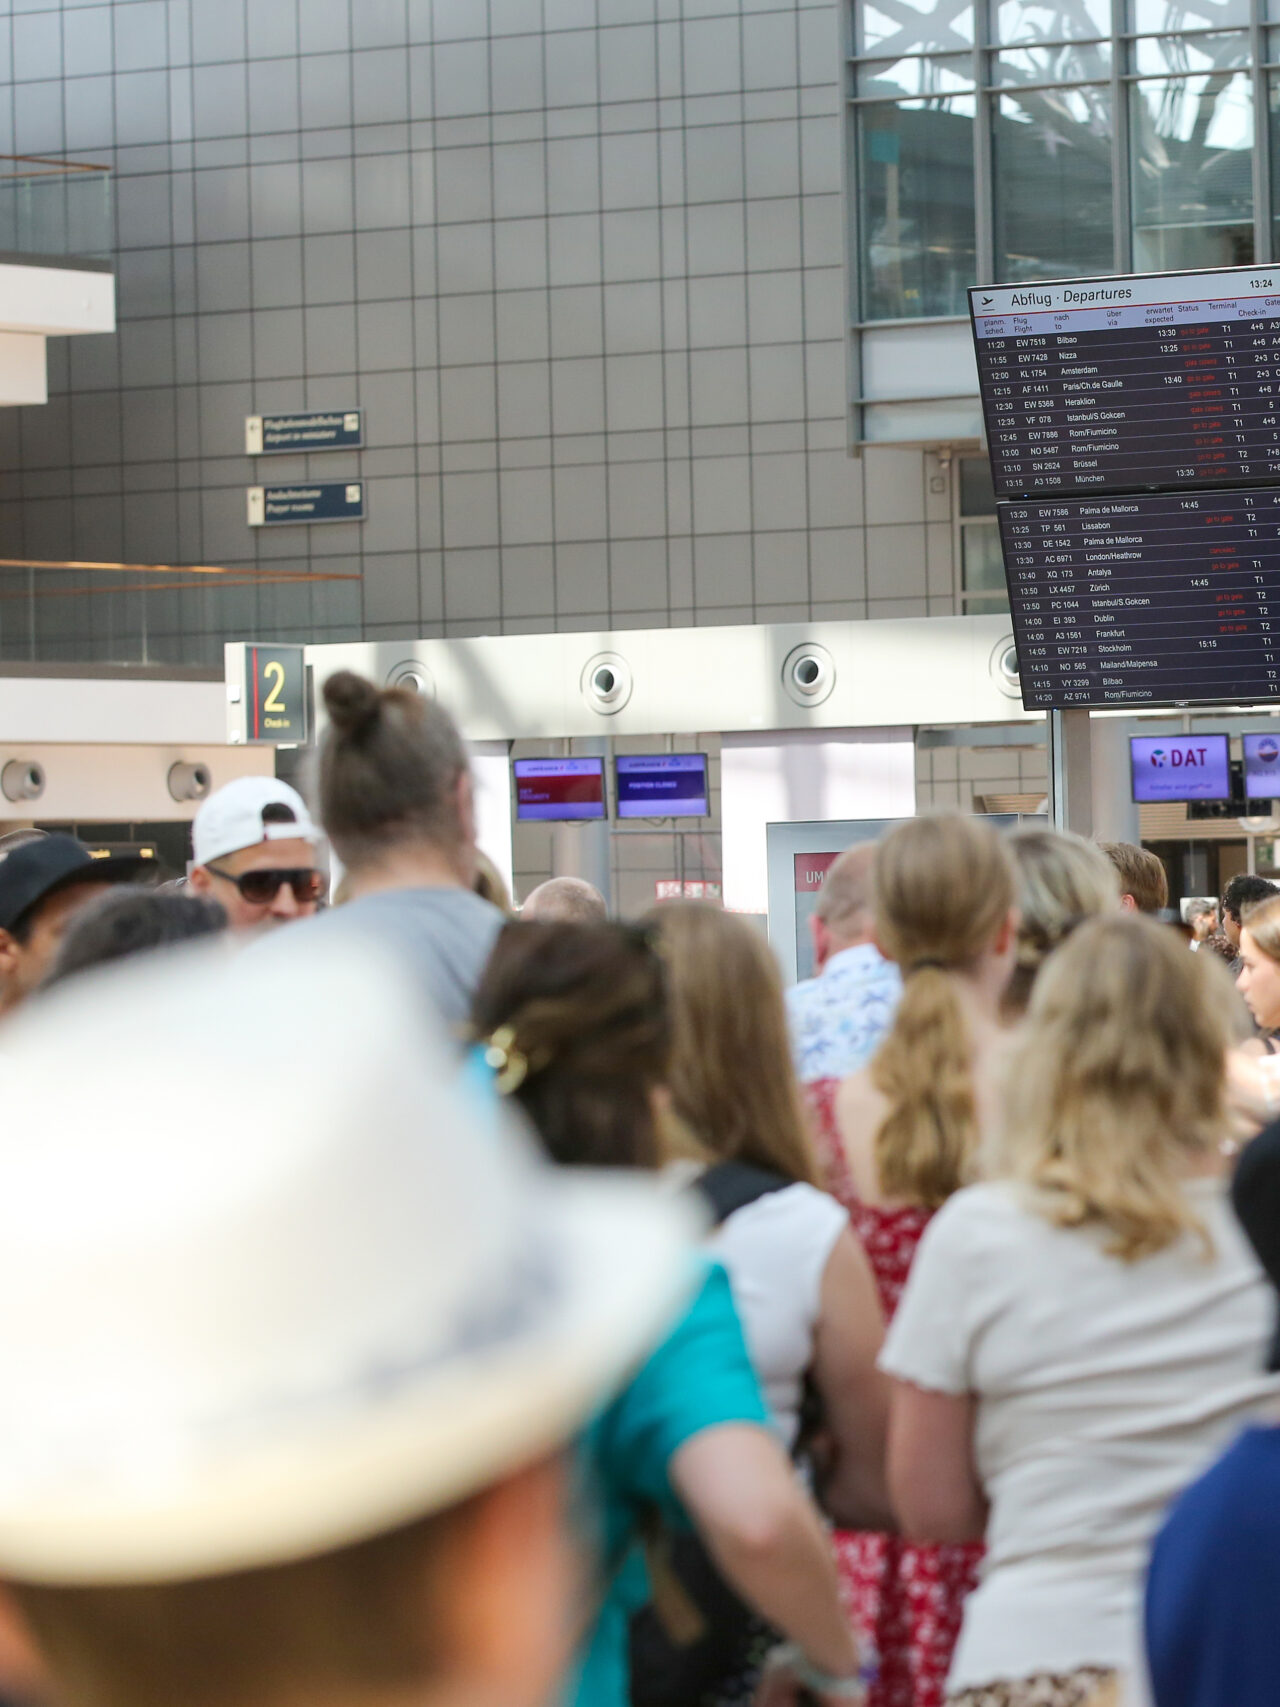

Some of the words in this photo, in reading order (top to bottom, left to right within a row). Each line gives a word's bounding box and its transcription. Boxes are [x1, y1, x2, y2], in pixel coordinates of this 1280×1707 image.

[1250, 279, 1273, 288] 13:24
[1011, 292, 1052, 307] Abflug
[1063, 288, 1132, 304] Departures
[991, 372, 1009, 380] 12:00
[1020, 370, 1030, 378] KL
[1061, 366, 1098, 375] Amsterdam
[1226, 356, 1235, 364] T1
[1254, 354, 1268, 362] 2+3
[1094, 614, 1115, 622] Dublin
[264, 661, 286, 712] 2
[1171, 748, 1207, 767] DAT
